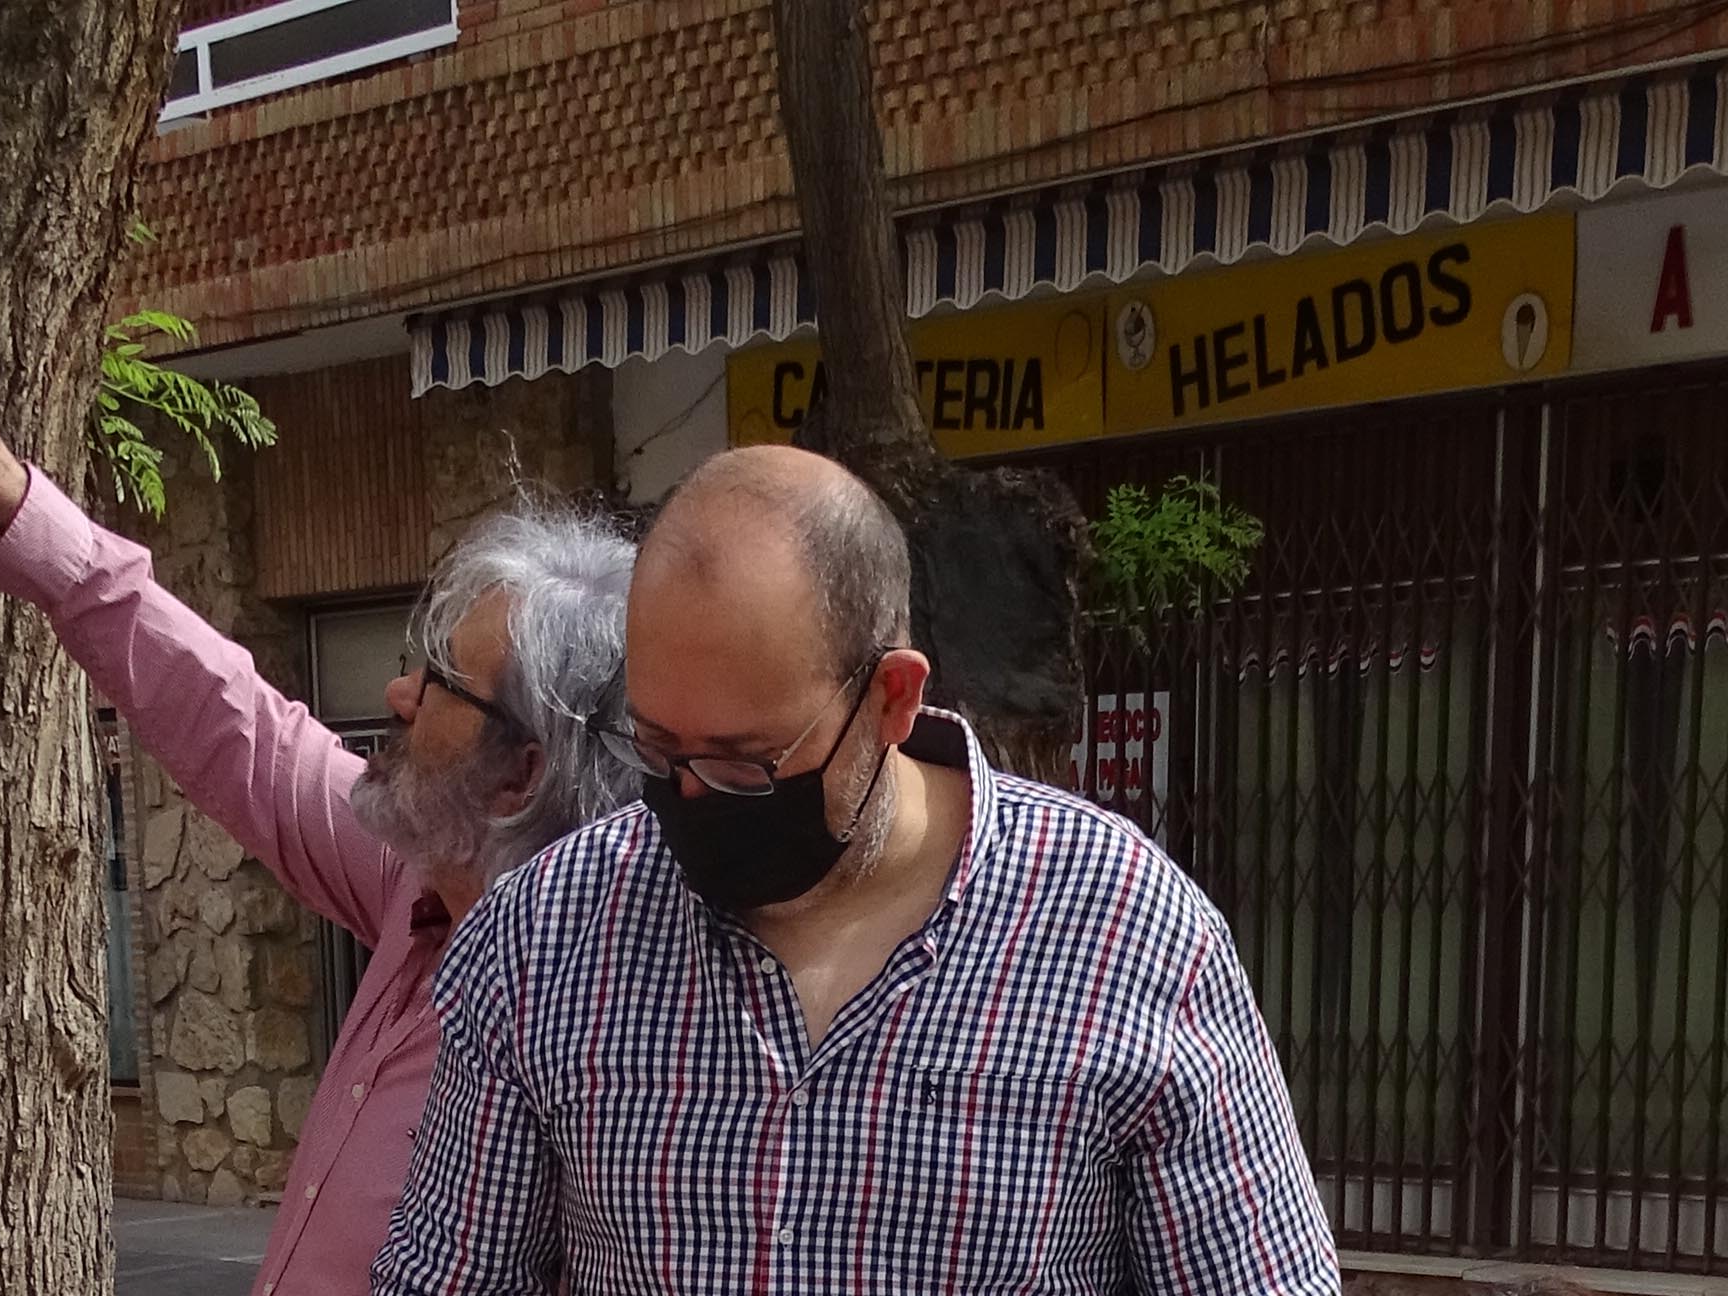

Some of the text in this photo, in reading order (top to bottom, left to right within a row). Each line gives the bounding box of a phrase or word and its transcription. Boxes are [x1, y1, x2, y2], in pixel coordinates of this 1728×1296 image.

[1169, 243, 1472, 417] HELADOS
[1651, 224, 1694, 333] A
[773, 358, 1045, 430] CATERIA
